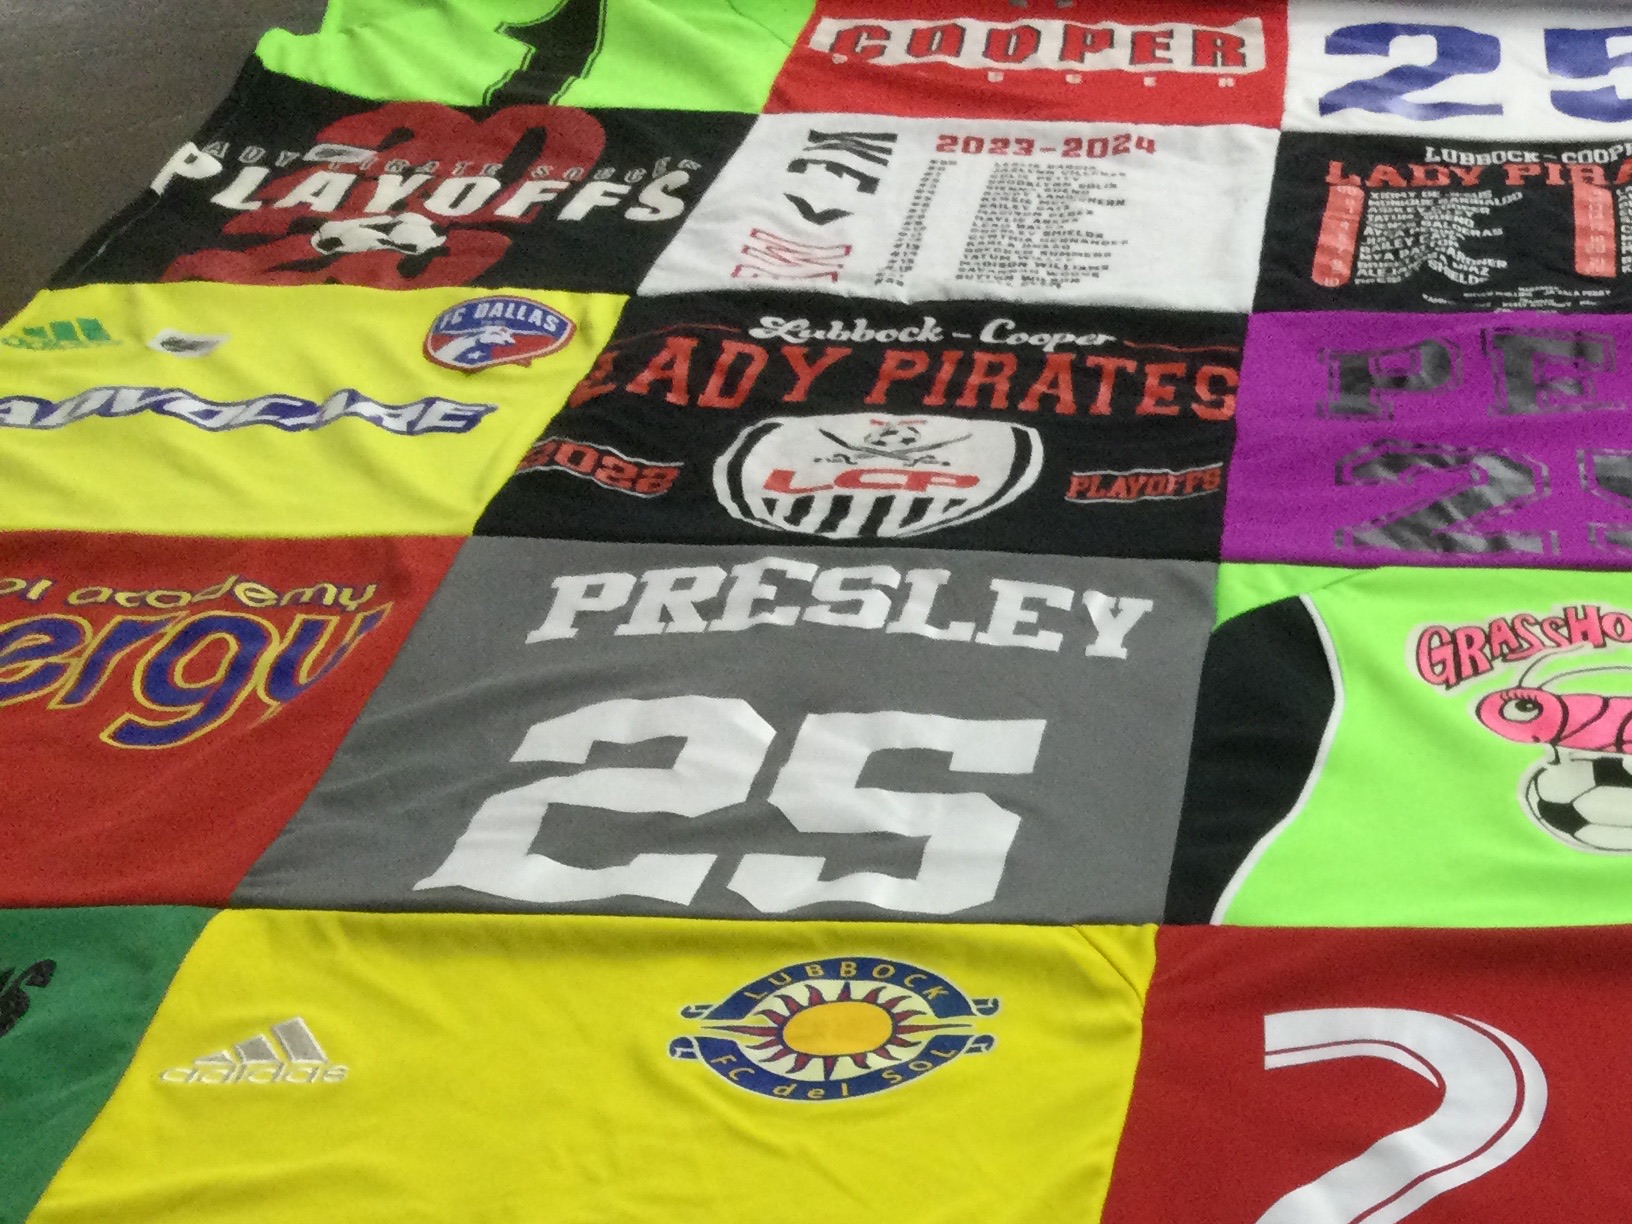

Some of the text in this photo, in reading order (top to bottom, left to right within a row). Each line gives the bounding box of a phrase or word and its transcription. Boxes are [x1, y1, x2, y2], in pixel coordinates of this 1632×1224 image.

[828, 22, 1248, 69] COOPER
[203, 141, 300, 168] ADY
[1325, 160, 1486, 188] LADY
[151, 141, 689, 223] PLAYOFFS
[473, 302, 560, 332] DALLAS
[863, 349, 1241, 421] PIRATES
[1066, 467, 1223, 499] PLAYOFFS
[68, 574, 378, 611] academy
[524, 556, 1153, 659] PRESLEY
[412, 695, 1048, 914] 25
[744, 961, 950, 1000] LUBBOCK
[160, 1061, 349, 1085] adidas
[710, 1053, 756, 1082] FC
[773, 1081, 849, 1101] del
